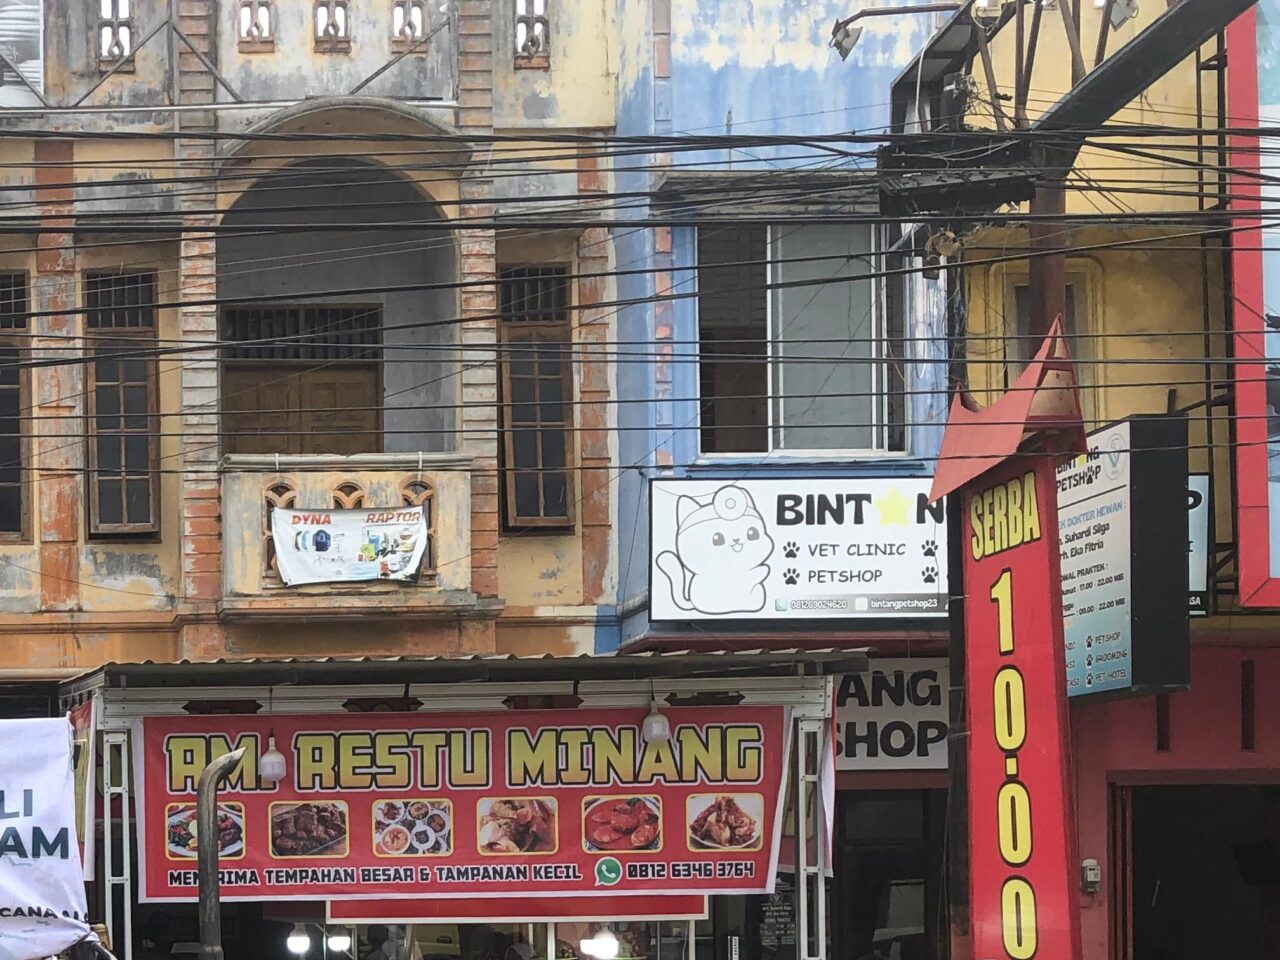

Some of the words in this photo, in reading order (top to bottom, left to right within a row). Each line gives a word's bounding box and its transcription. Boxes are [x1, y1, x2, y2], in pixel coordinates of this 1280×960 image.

[292, 514, 332, 526] DYNA
[365, 511, 420, 524] RAPTOR
[970, 471, 1042, 561] SERBA
[808, 543, 840, 557] VET
[846, 543, 906, 556] CLINIC
[808, 570, 882, 583] PETSHOP
[297, 729, 474, 790] RESTU
[509, 725, 762, 786] MINANG
[168, 867, 260, 886] MENRIMA
[265, 867, 356, 884] TEMPAHAN
[360, 866, 414, 883] BESAR
[418, 865, 429, 882] &
[436, 864, 529, 882] TAMPANAN
[532, 863, 582, 881] KECIL
[627, 862, 666, 879] 0812
[670, 862, 714, 878] 6346
[717, 861, 755, 878] 3764
